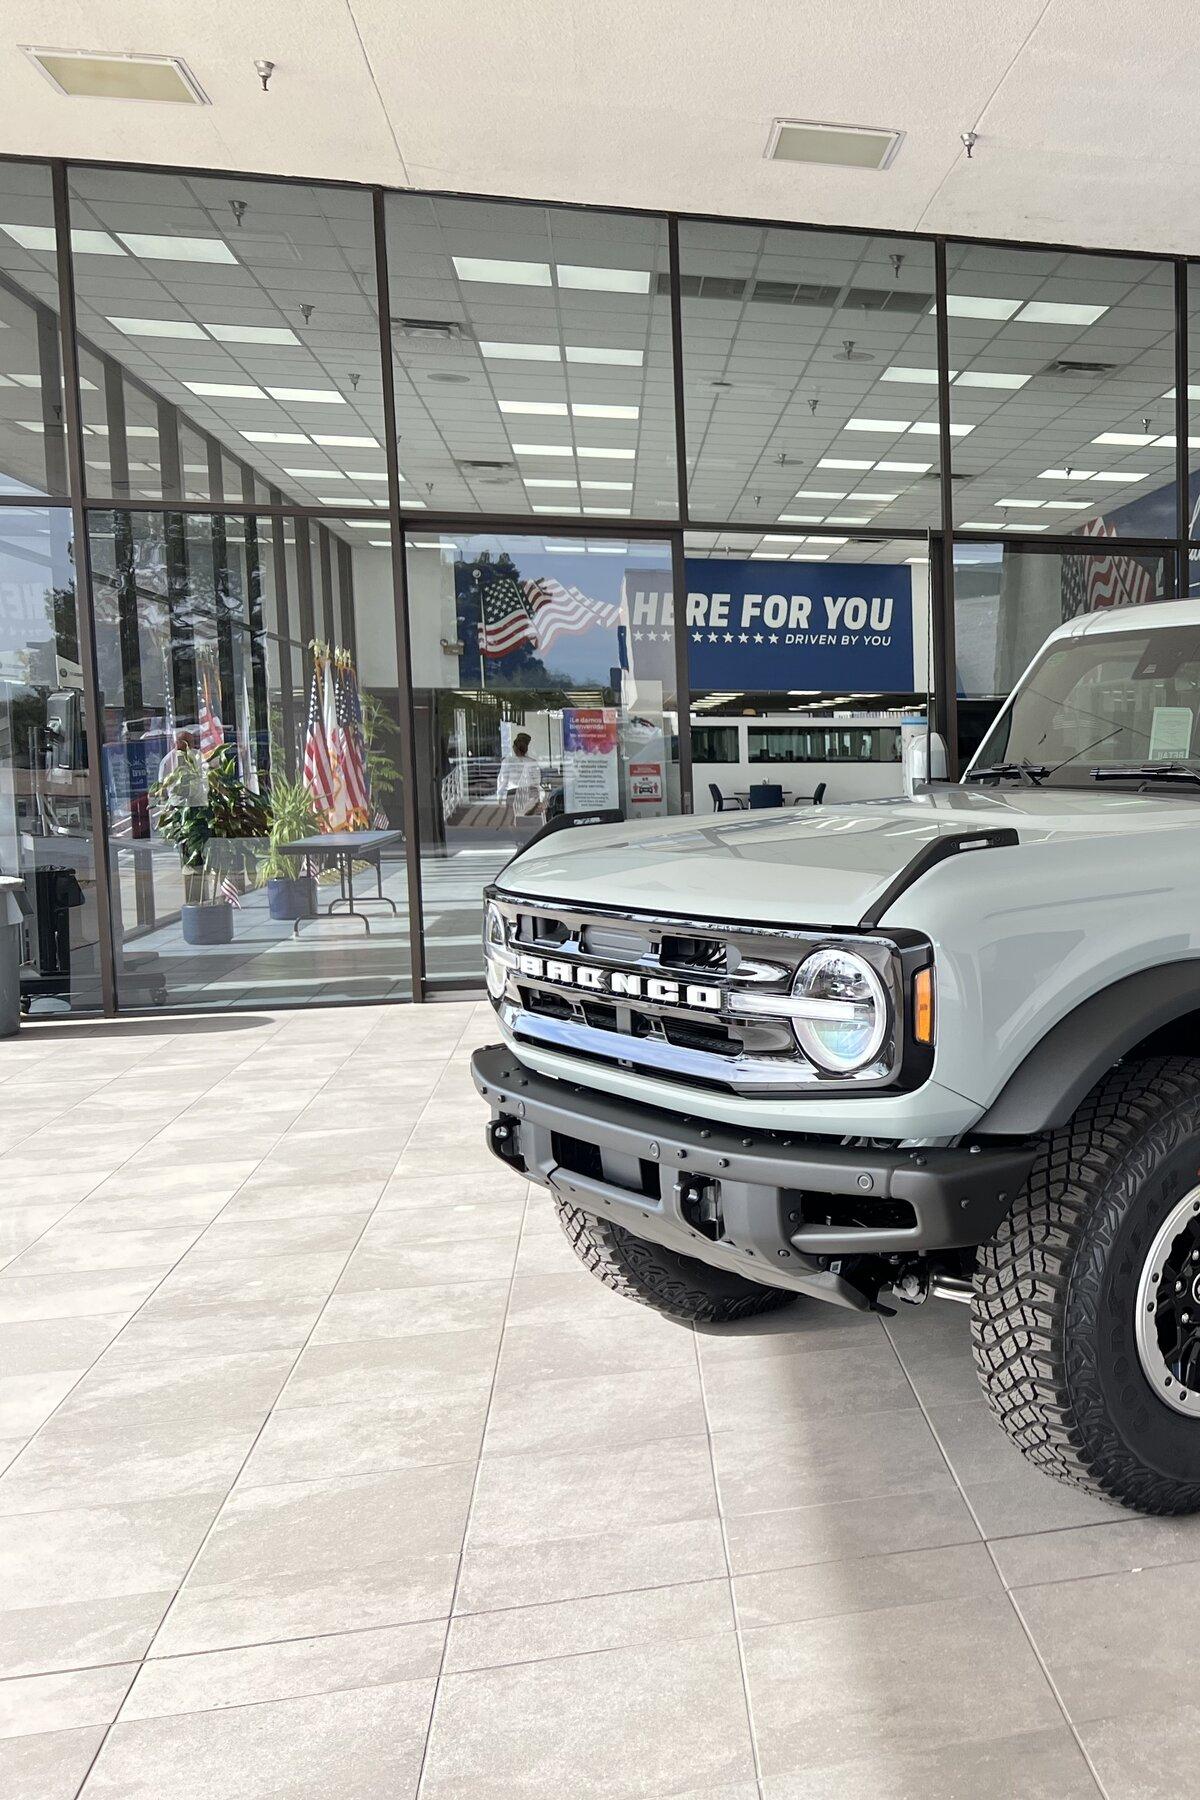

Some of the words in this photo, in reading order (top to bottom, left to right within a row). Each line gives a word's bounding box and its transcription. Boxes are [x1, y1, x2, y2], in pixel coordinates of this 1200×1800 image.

[632, 591, 731, 628] HERE
[740, 593, 812, 629] FOR
[823, 596, 894, 631] YOU
[784, 633, 837, 646] DRIVEN
[841, 635, 859, 646] BY
[863, 635, 892, 647] YOU
[520, 954, 722, 1009] BRONCO
